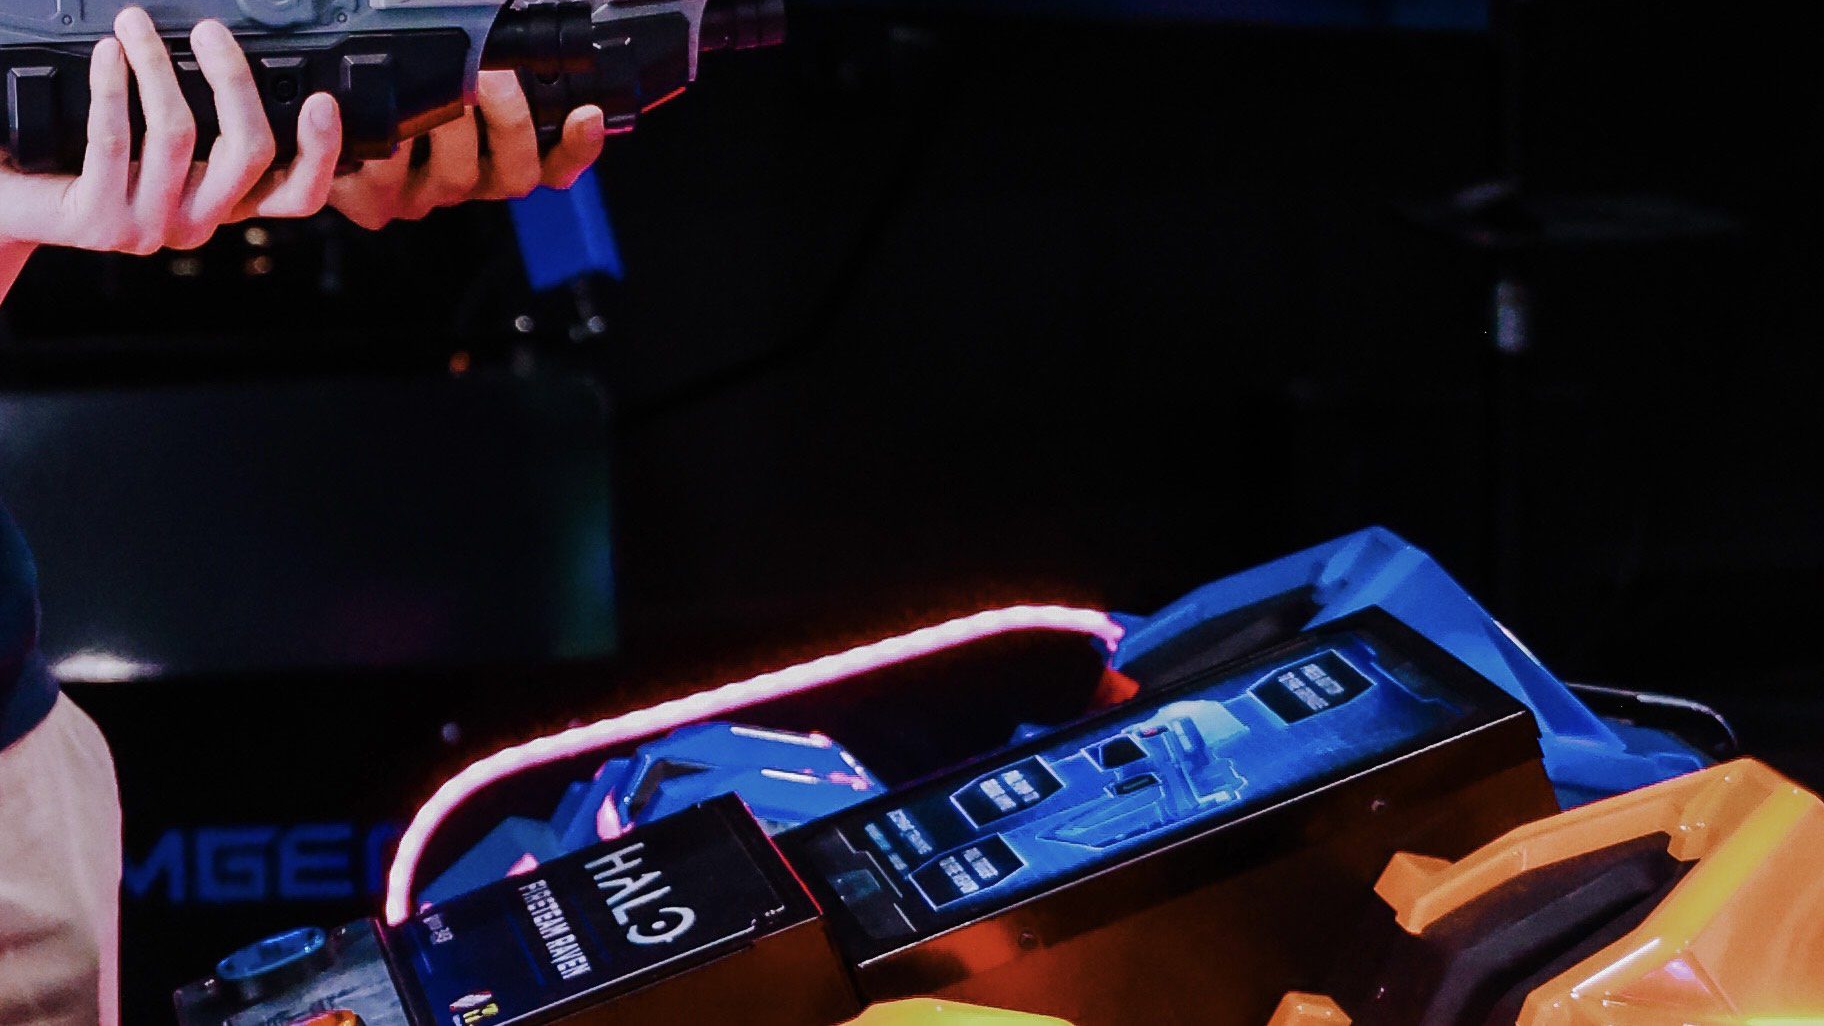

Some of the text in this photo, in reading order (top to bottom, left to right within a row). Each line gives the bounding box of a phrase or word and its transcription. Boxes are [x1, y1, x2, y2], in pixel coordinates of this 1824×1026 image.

[518, 878, 592, 980] FIRETEAM RAVEN
[583, 841, 697, 945] HALO
